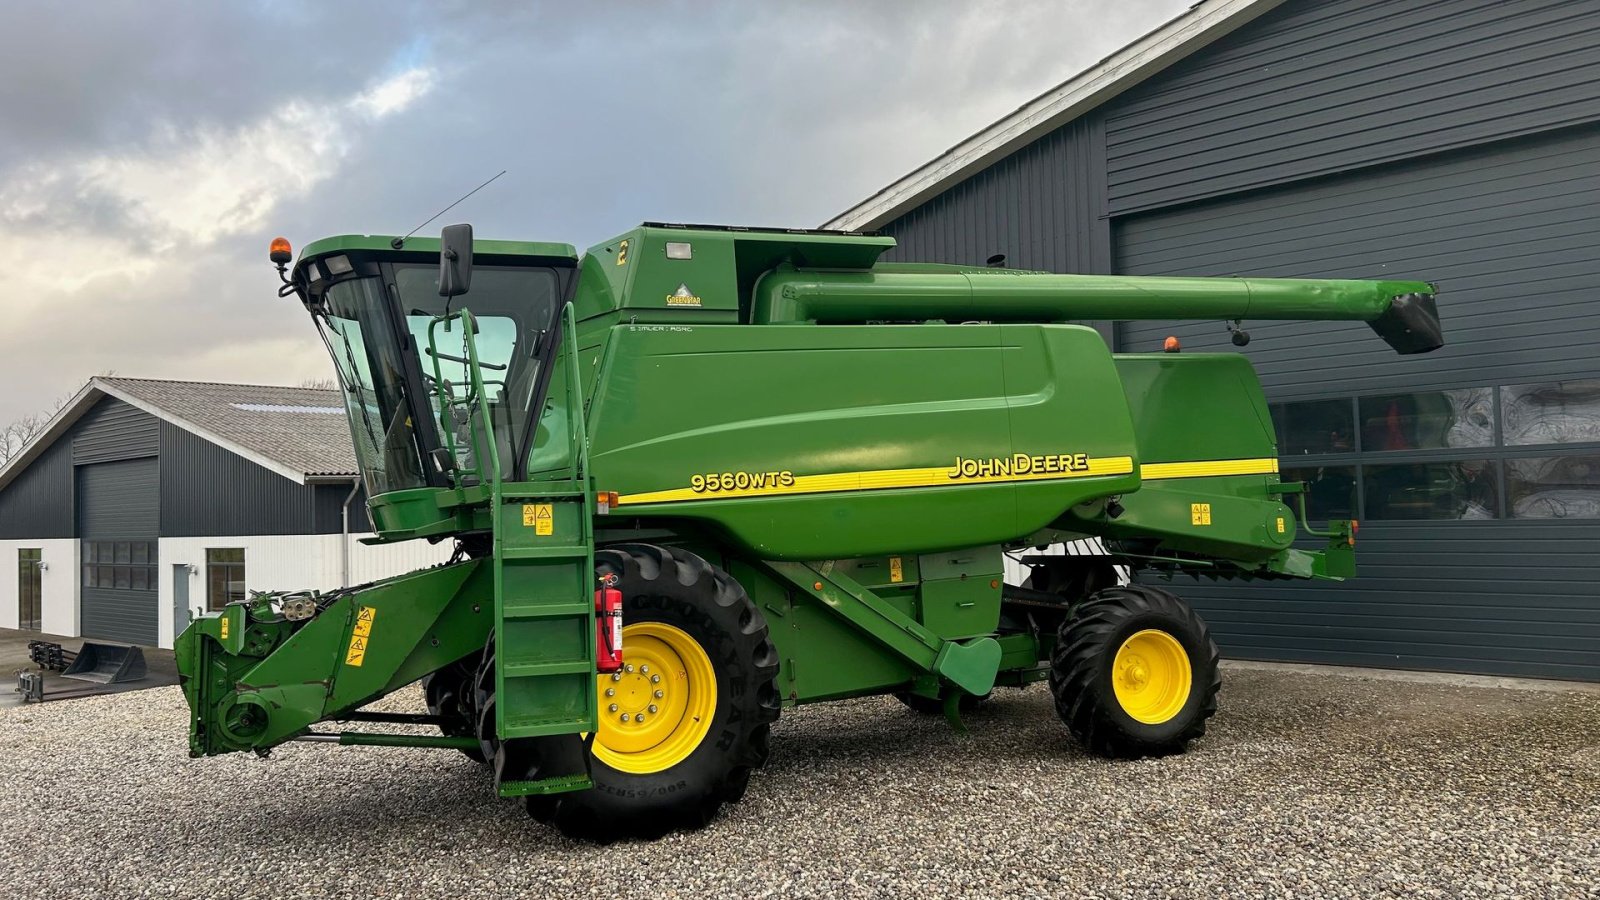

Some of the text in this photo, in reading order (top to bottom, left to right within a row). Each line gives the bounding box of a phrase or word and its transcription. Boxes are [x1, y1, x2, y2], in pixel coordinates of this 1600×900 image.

[948, 452, 1089, 479] JOHN DEERE
[690, 470, 795, 493] 9560WTS
